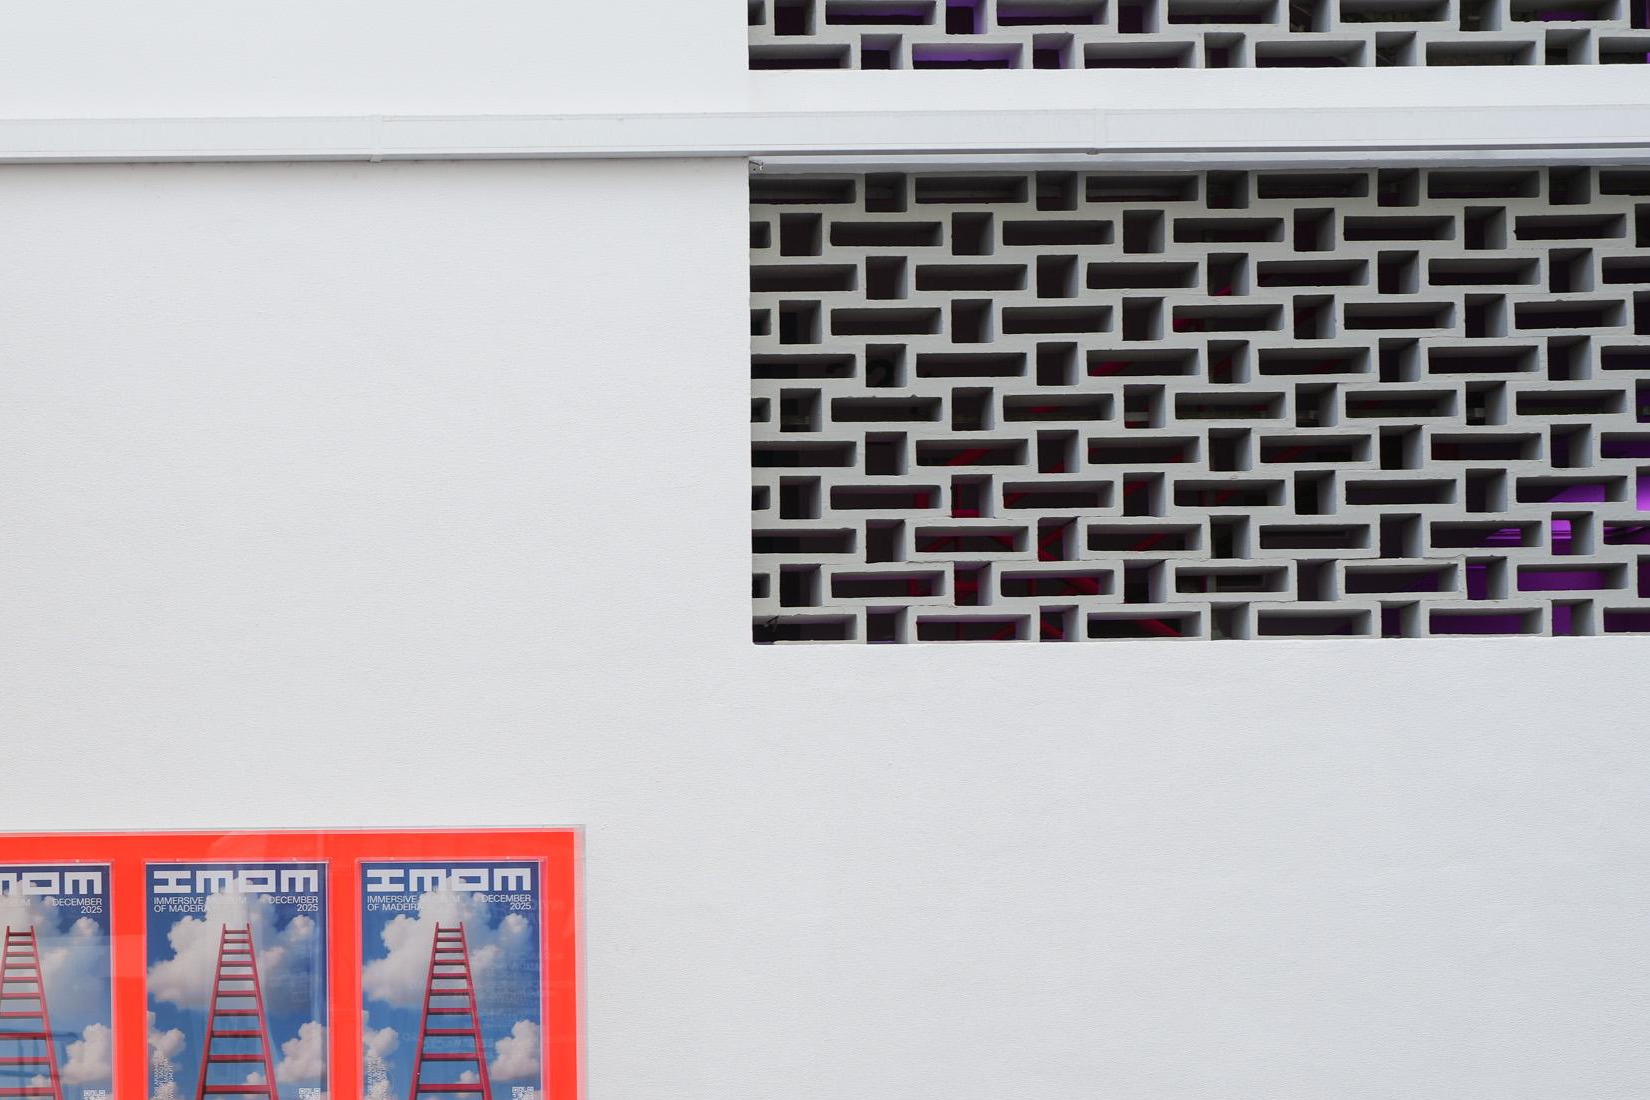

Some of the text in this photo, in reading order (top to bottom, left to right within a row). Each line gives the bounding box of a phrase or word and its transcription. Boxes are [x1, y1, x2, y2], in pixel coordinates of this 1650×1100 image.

[52, 898, 103, 907] DECEMBER
[153, 897, 205, 905] IMMERSIVE
[268, 896, 319, 904] DECEMBER
[367, 895, 418, 903] IMMERSIVE
[481, 894, 532, 903] DECEMBER
[80, 906, 103, 914] 2025
[153, 904, 167, 913] OF
[296, 904, 319, 912] 2025
[367, 903, 380, 912] OF
[509, 902, 532, 911] 2025
